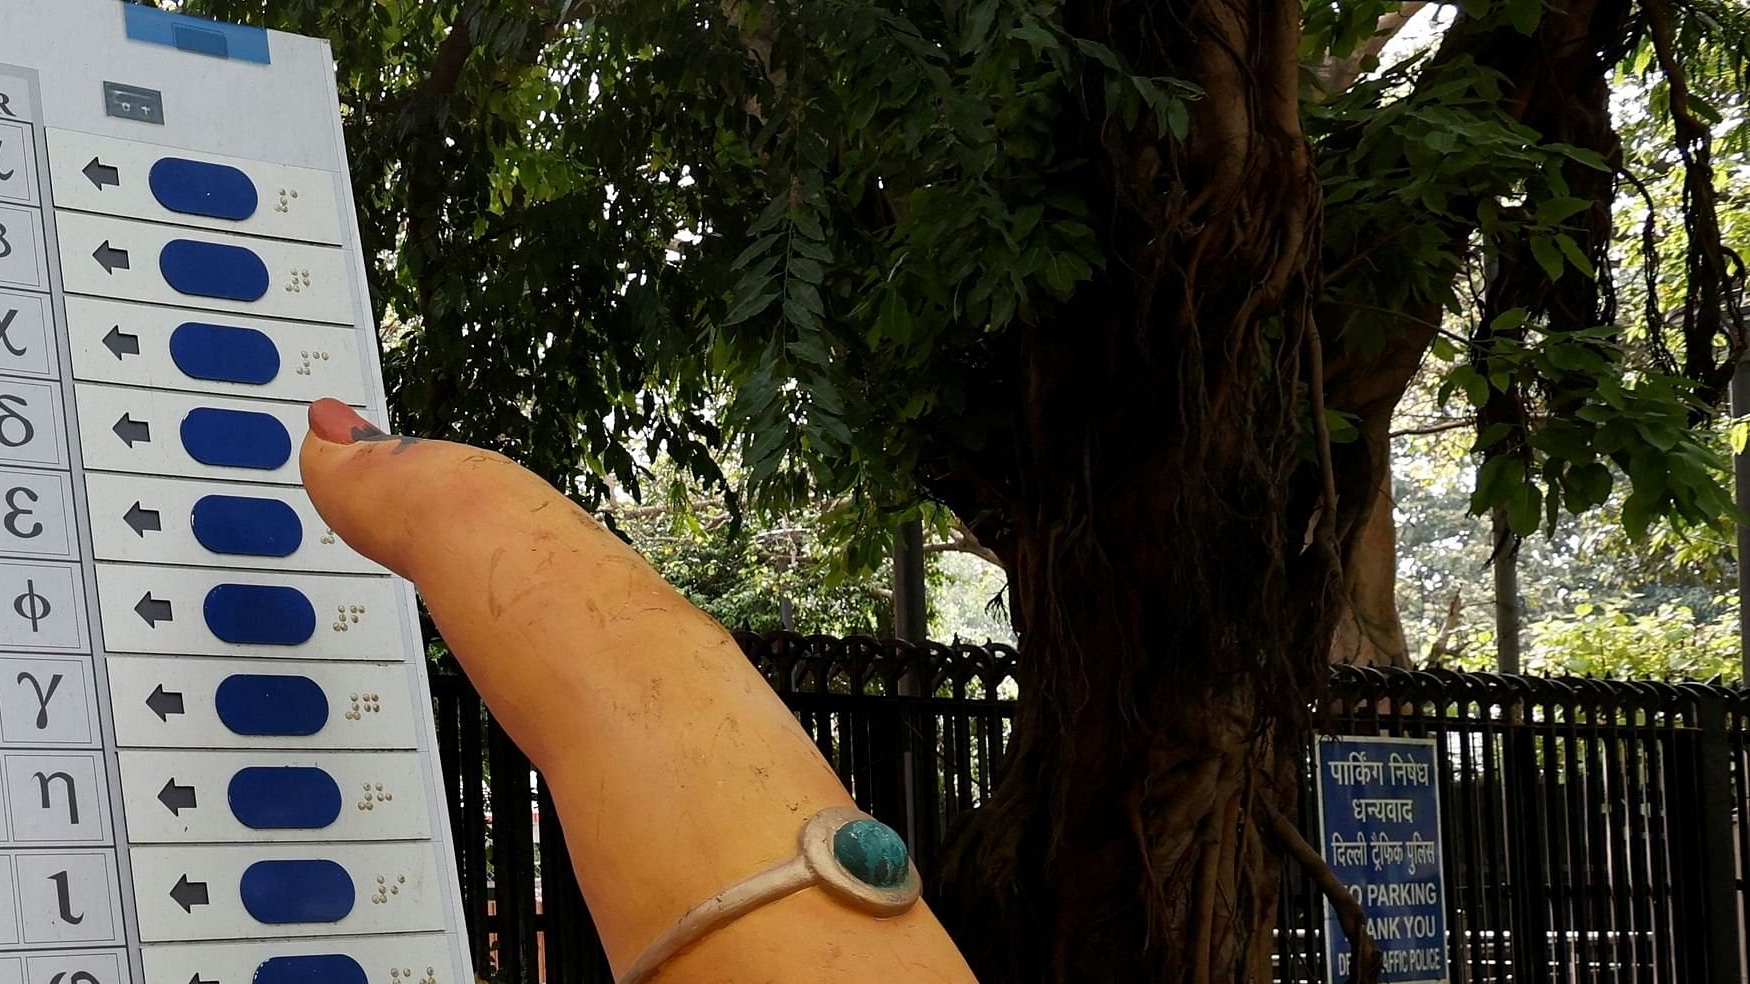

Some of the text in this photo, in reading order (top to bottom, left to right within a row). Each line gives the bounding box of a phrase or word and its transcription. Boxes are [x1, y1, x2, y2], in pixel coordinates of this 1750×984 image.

[1328, 752, 1429, 786] पार्किंग निषेध
[1353, 799, 1413, 823] धन्यवाद
[1331, 832, 1367, 866] दिल्ली
[1405, 832, 1435, 875] पुलिस
[1344, 883, 1437, 906] O PARKING
[1403, 916, 1436, 938] YOU
[1411, 949, 1441, 971] POLICE
